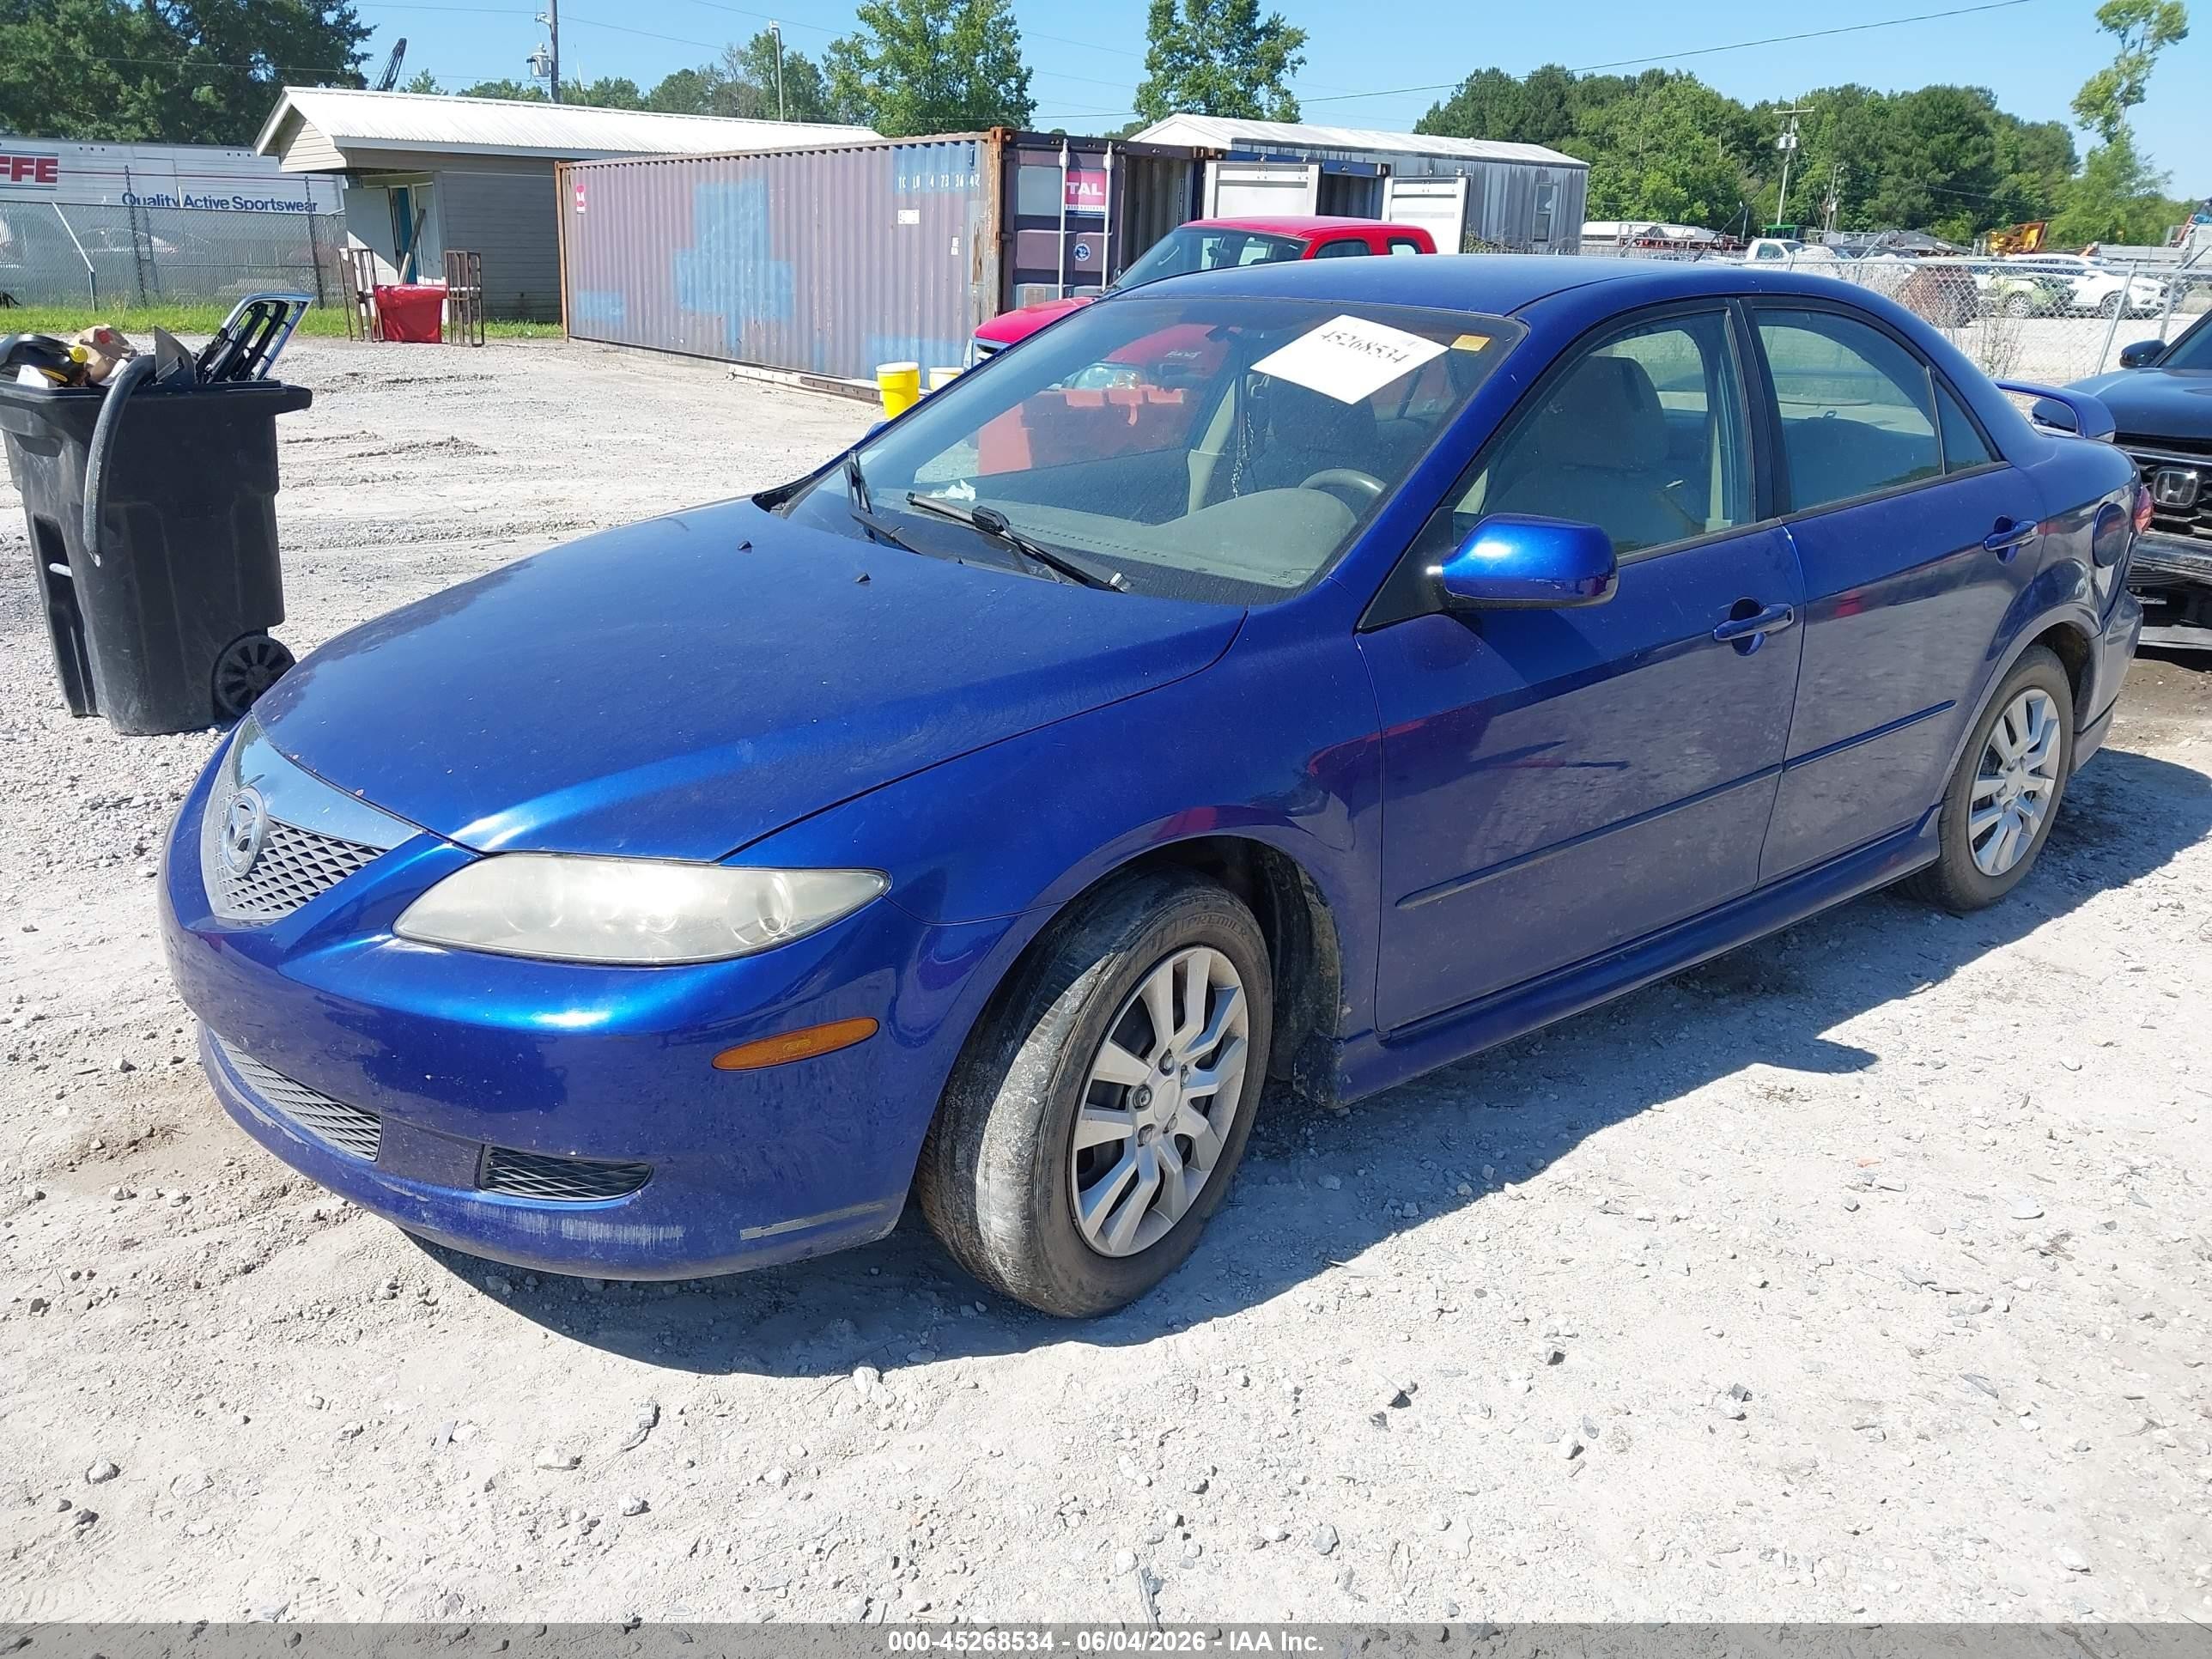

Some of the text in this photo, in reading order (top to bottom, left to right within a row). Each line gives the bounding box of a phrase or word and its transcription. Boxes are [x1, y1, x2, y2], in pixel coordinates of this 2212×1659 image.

[1066, 181, 1103, 196] TAL
[122, 192, 318, 212] Quality Active Sportswear
